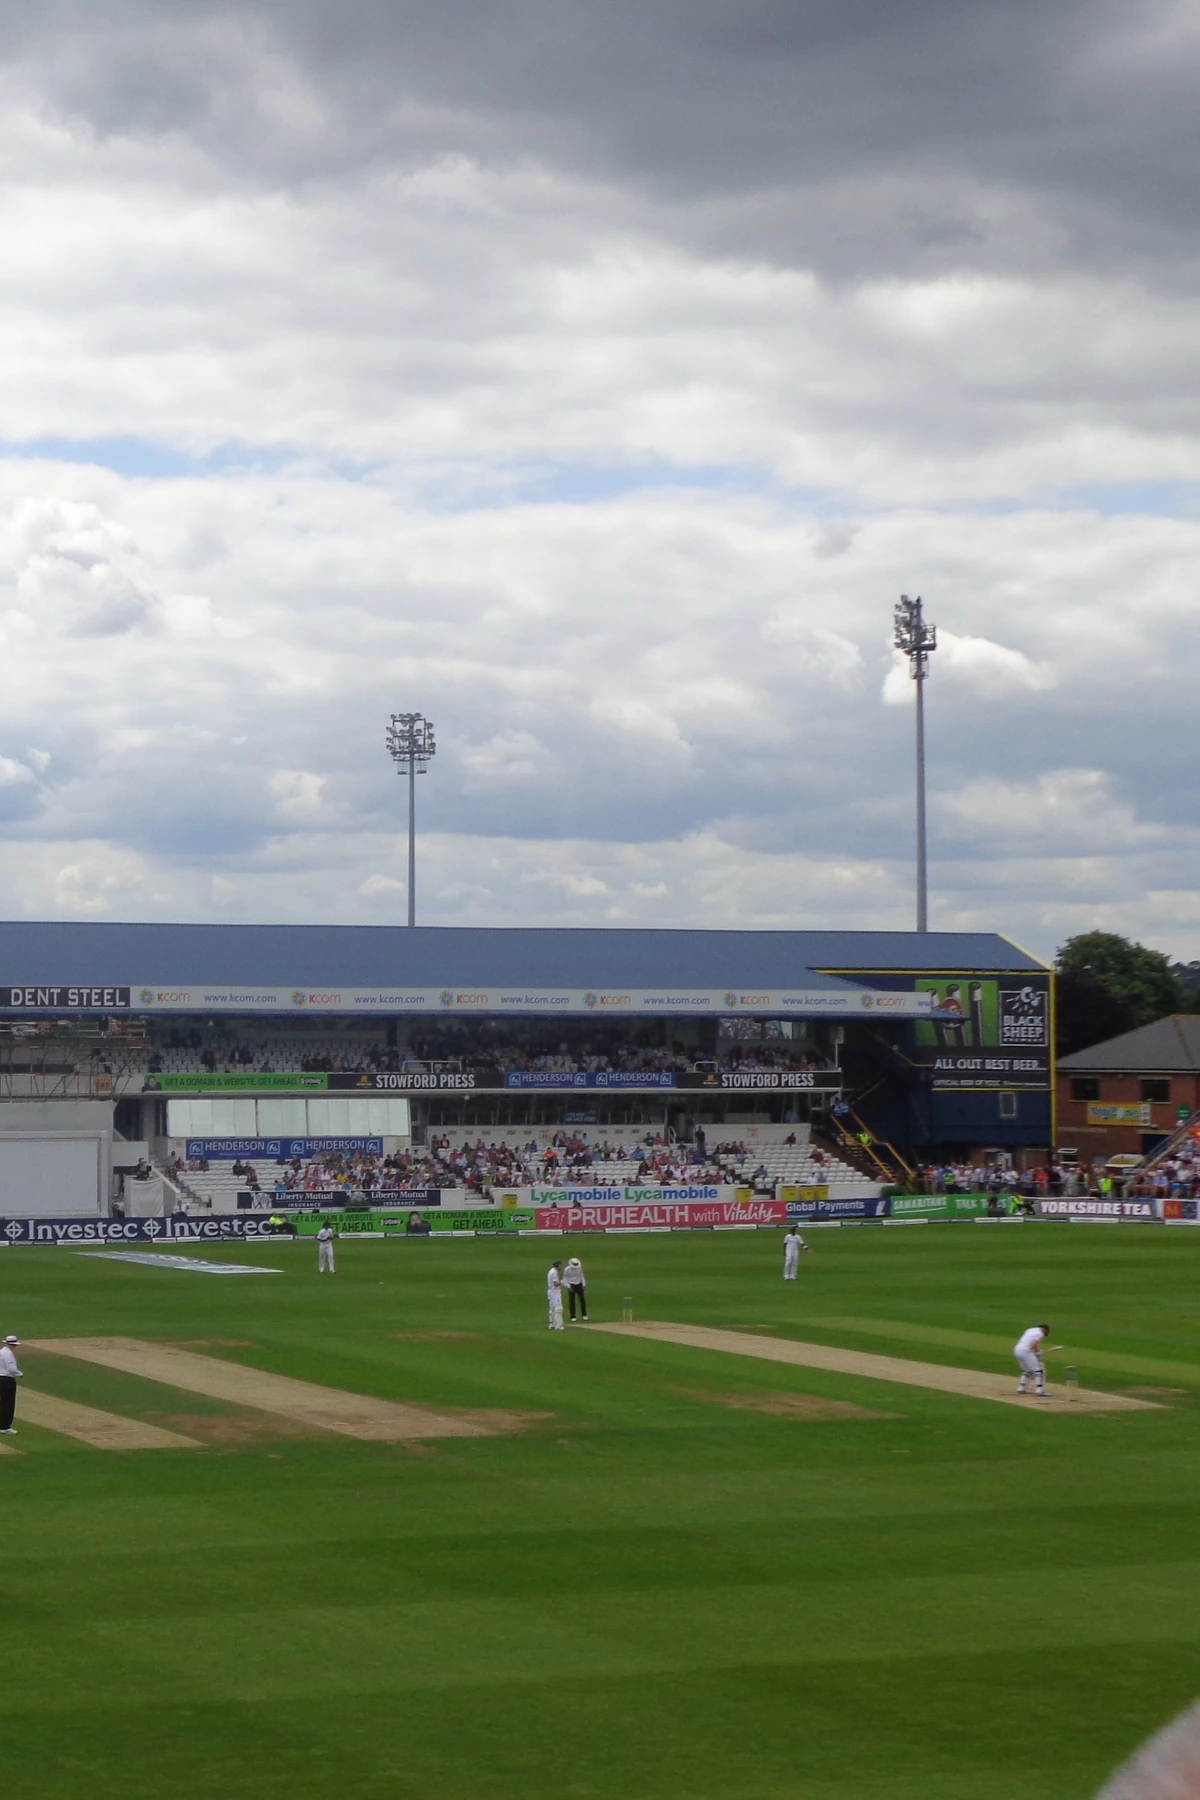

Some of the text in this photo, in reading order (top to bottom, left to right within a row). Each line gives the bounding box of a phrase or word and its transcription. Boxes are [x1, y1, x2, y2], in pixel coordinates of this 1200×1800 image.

[10, 988, 126, 1006] DENT STEEL
[204, 992, 277, 1003] www.kcom.com
[354, 993, 425, 1004] www.kcom.com
[500, 995, 570, 1005] www.kcom.com
[643, 996, 711, 1006] www.kcom.com
[781, 997, 848, 1006] www.kcom.com
[1002, 1015, 1043, 1027] BLACK
[1002, 1026, 1043, 1038] SHEEP
[933, 1058, 956, 1070] ALL
[956, 1059, 981, 1070] OUT
[985, 1059, 1010, 1070] BEST
[375, 1074, 475, 1088] STOWFORD PRESS
[522, 1073, 574, 1082] HENDERSON
[608, 1073, 660, 1082] HENDERSON
[721, 1073, 815, 1087] STOWFORD PRESS
[205, 1141, 265, 1151] HENDERSON
[305, 1140, 365, 1150] HENDERSON
[276, 1192, 333, 1202] Liberty Mutual
[371, 1191, 428, 1200] Liberty Mutual
[530, 1185, 718, 1203] Lycamobile Lycamobile
[785, 1201, 865, 1213] Global Payments
[1041, 1201, 1151, 1216] YORKSHIRE TEA
[291, 1215, 304, 1223] GET
[305, 1215, 311, 1223] A
[311, 1214, 338, 1222] DOMAIN
[423, 1212, 436, 1220] GET
[442, 1211, 469, 1219] DOMAIN
[567, 1202, 782, 1226] PRUHEALTH with Vitality
[166, 1217, 272, 1238] Investec
[341, 1222, 376, 1233] AHEAD.
[453, 1220, 470, 1230] GET
[472, 1218, 507, 1229] AHEAD.
[28, 1220, 138, 1240] Investec
